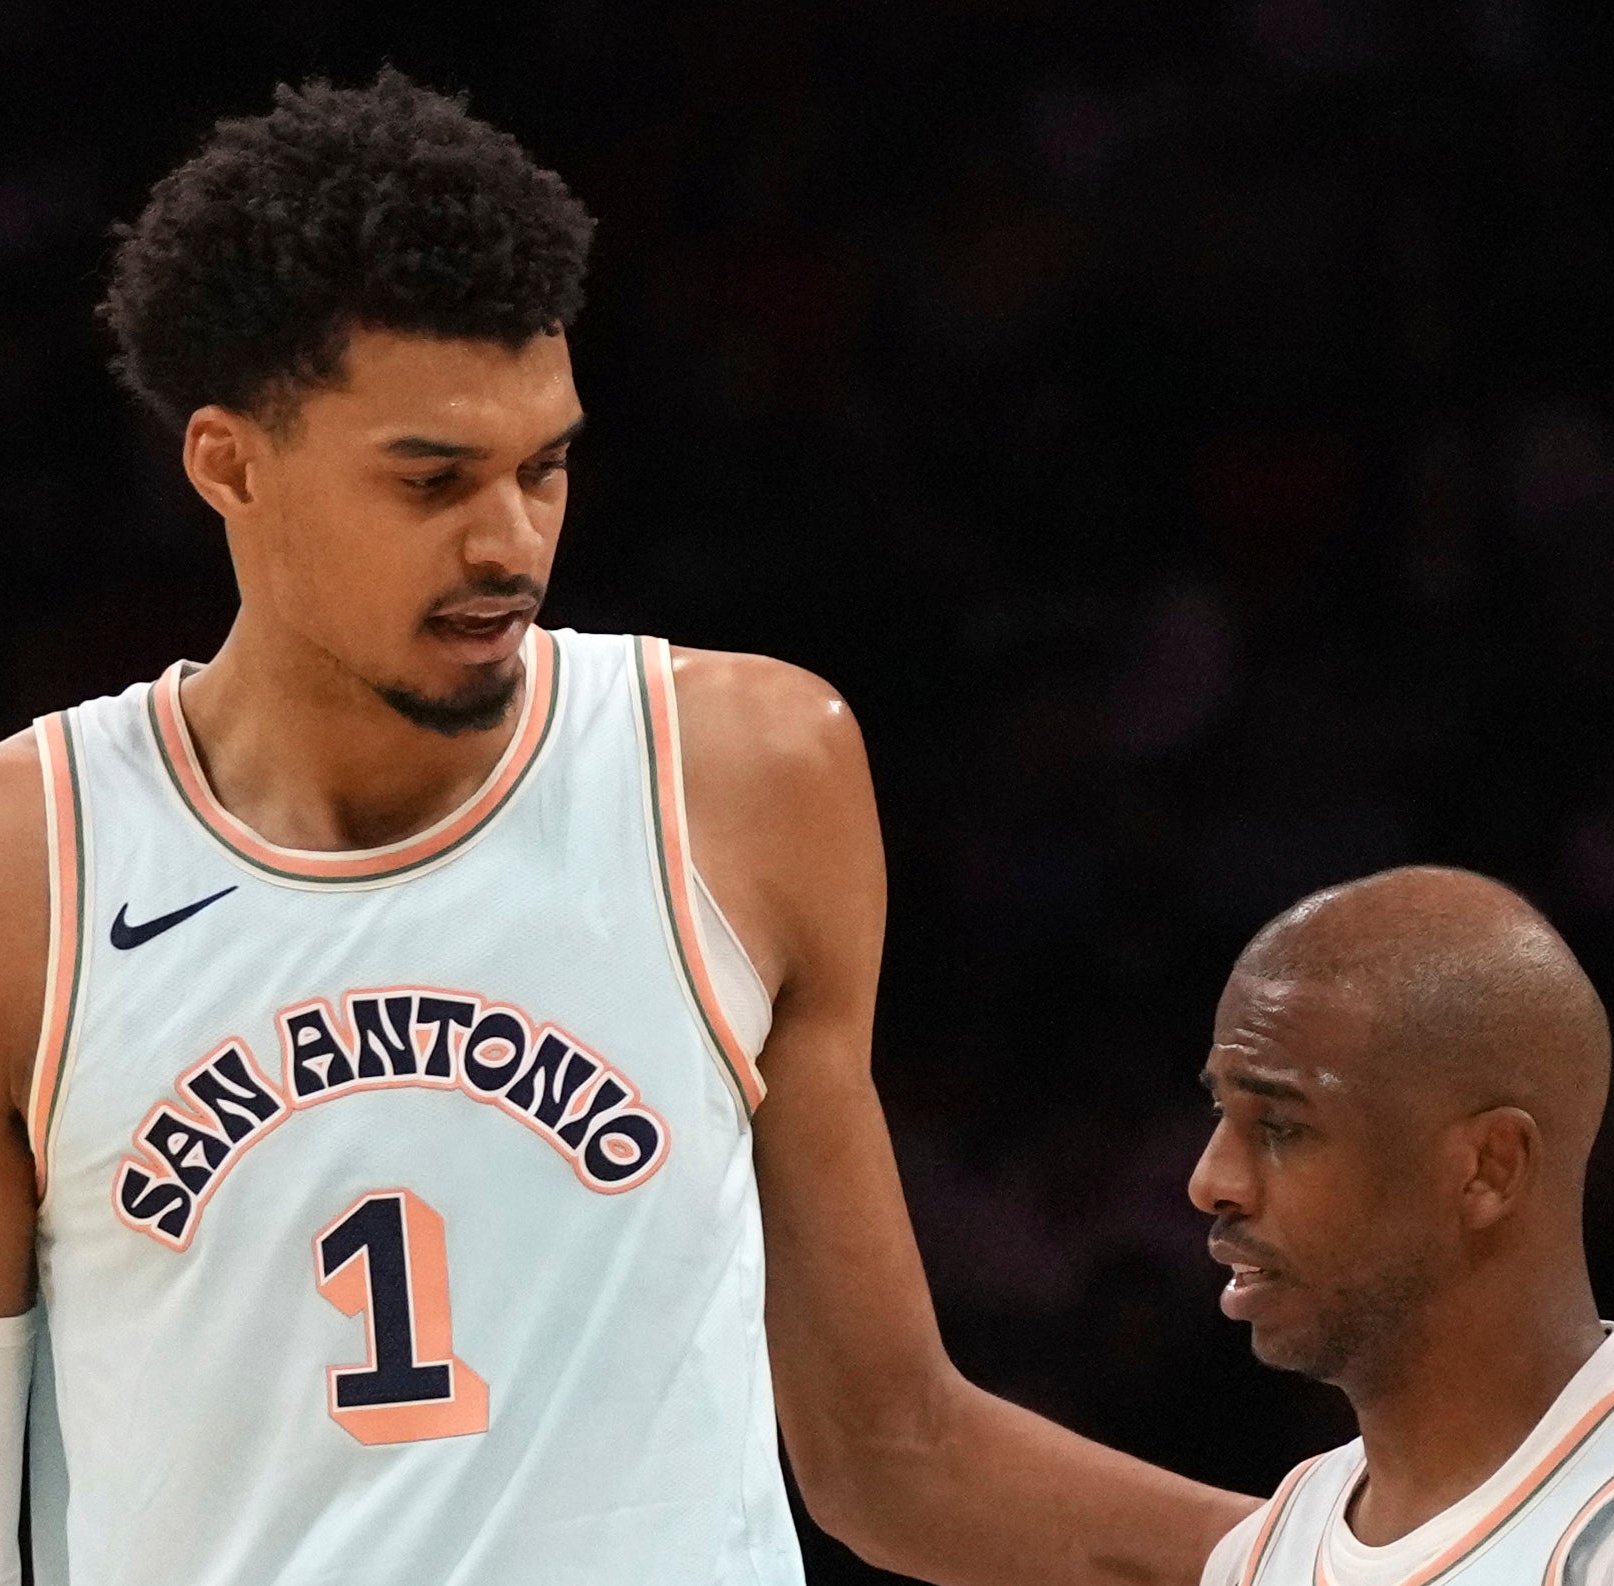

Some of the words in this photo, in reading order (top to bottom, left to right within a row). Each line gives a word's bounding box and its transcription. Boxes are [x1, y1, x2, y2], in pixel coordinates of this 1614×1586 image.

[114, 1038, 289, 1248] SAN
[278, 988, 668, 1191] ANTONIO
[315, 1189, 477, 1432] 1
